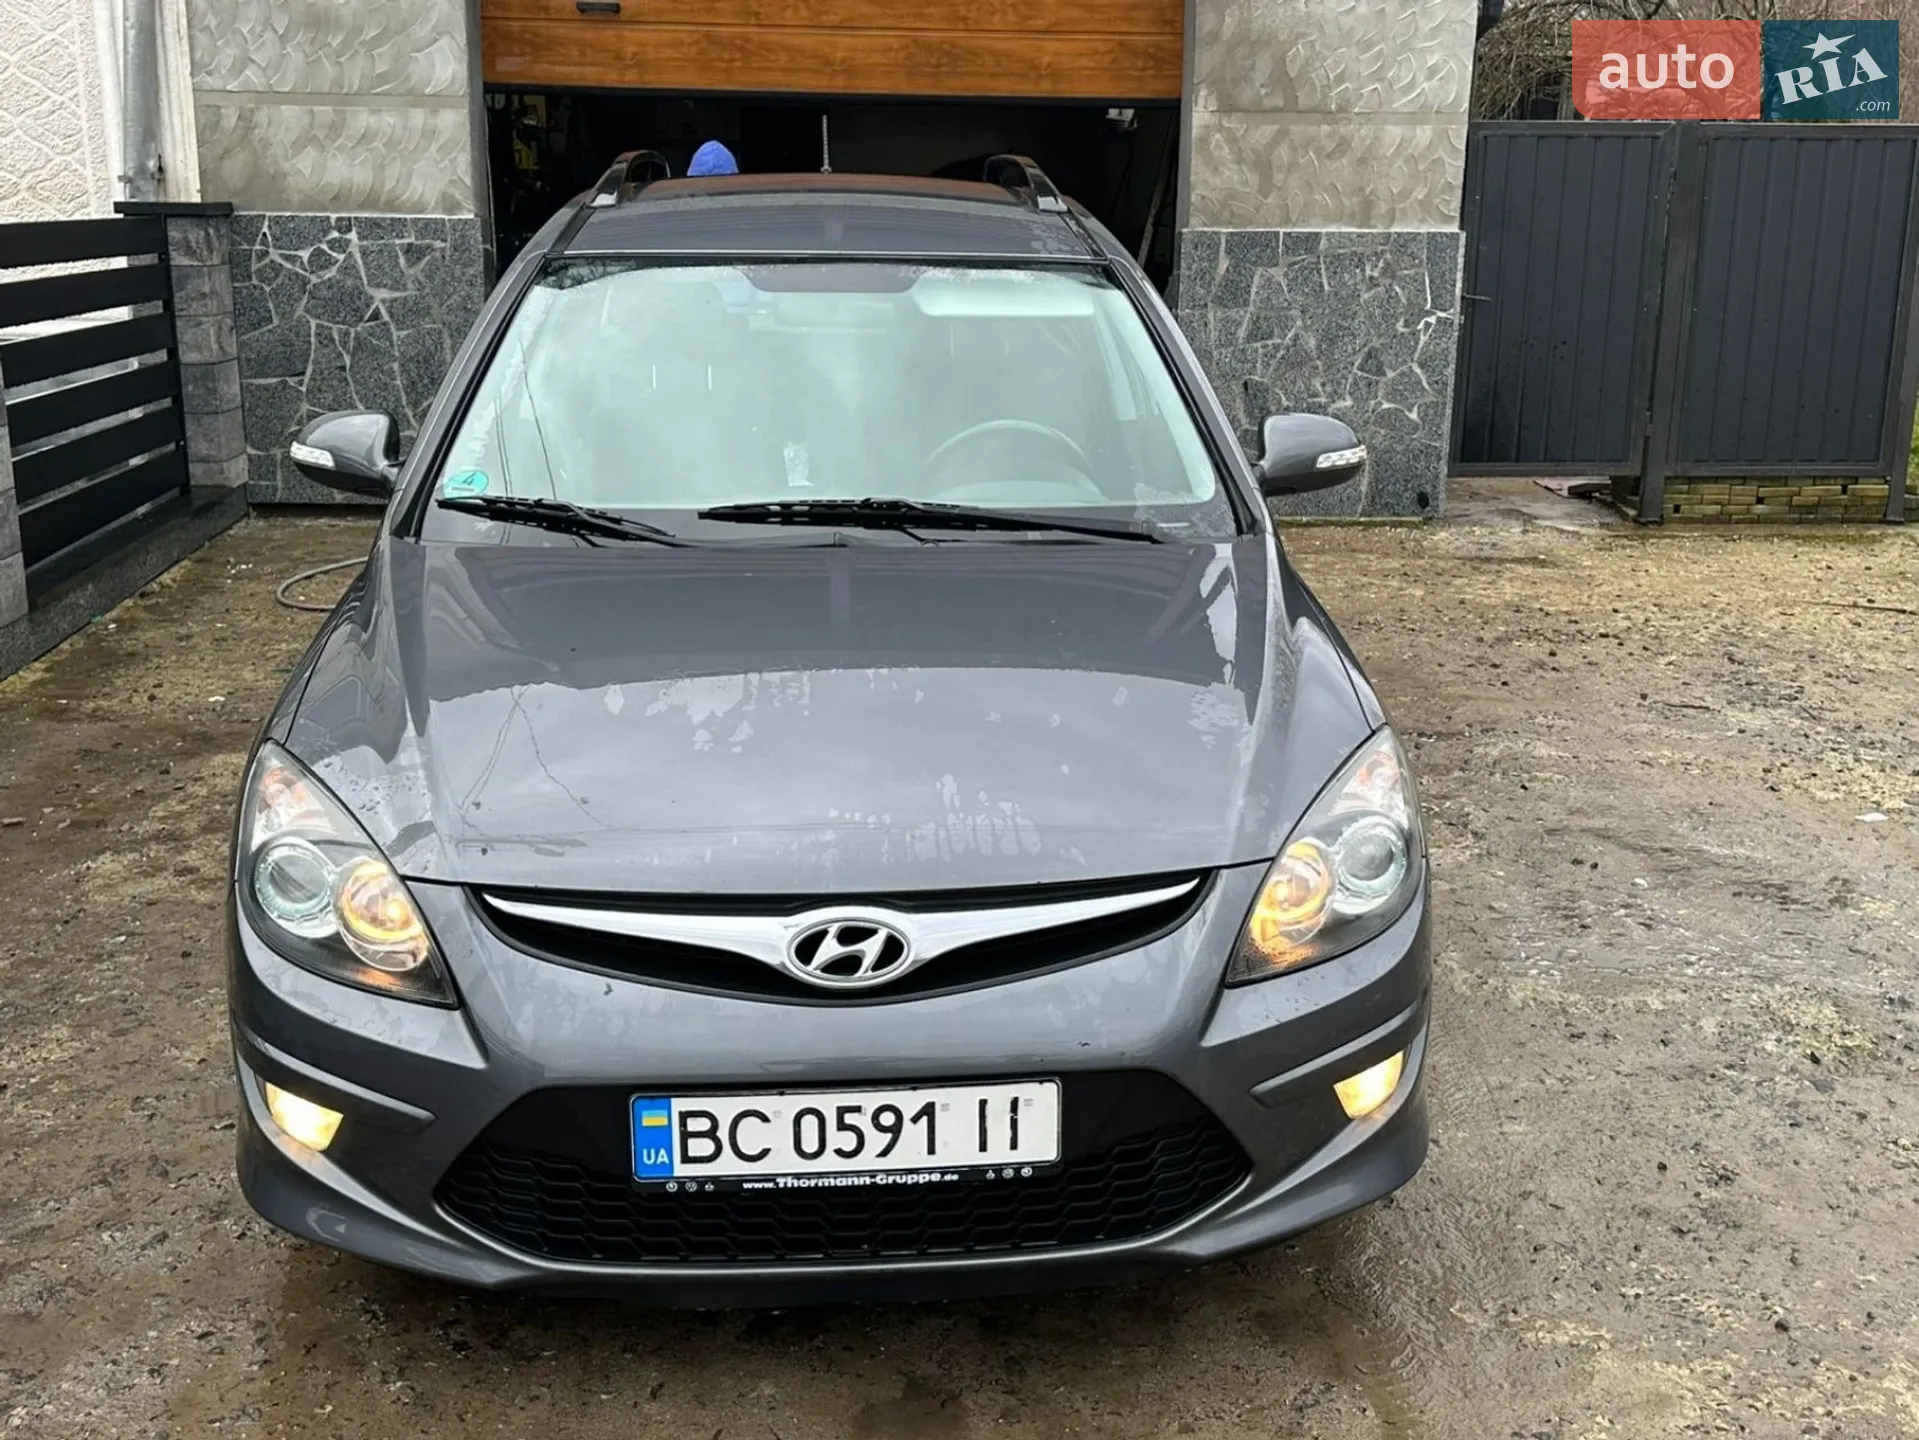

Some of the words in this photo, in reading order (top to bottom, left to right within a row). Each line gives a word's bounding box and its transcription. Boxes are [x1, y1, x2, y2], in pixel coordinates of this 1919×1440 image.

[678, 1108, 773, 1164] BC
[792, 1100, 937, 1161] 0591
[978, 1096, 1020, 1153] II
[642, 1148, 670, 1165] UA
[742, 1171, 960, 1189] www.Thormann-Gruppe.de
